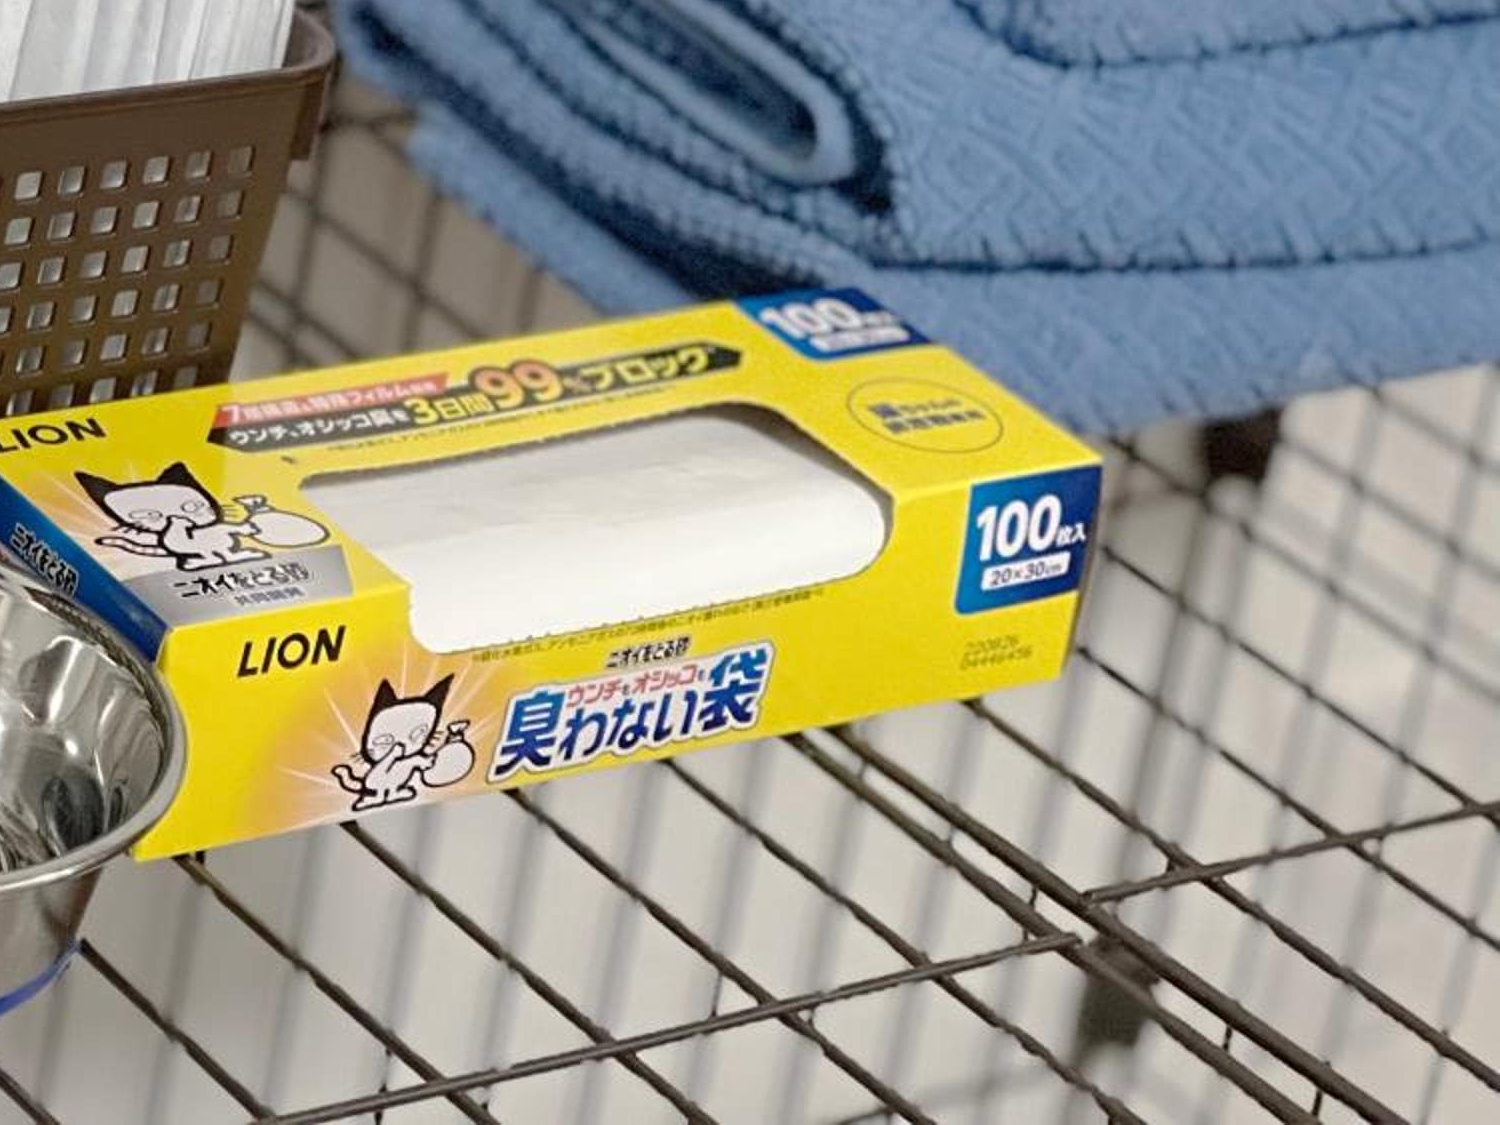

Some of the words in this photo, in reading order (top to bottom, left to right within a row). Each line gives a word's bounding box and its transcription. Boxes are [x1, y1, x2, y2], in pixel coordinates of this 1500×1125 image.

[236, 624, 347, 679] LION
[495, 648, 770, 776] 臭わない袋
